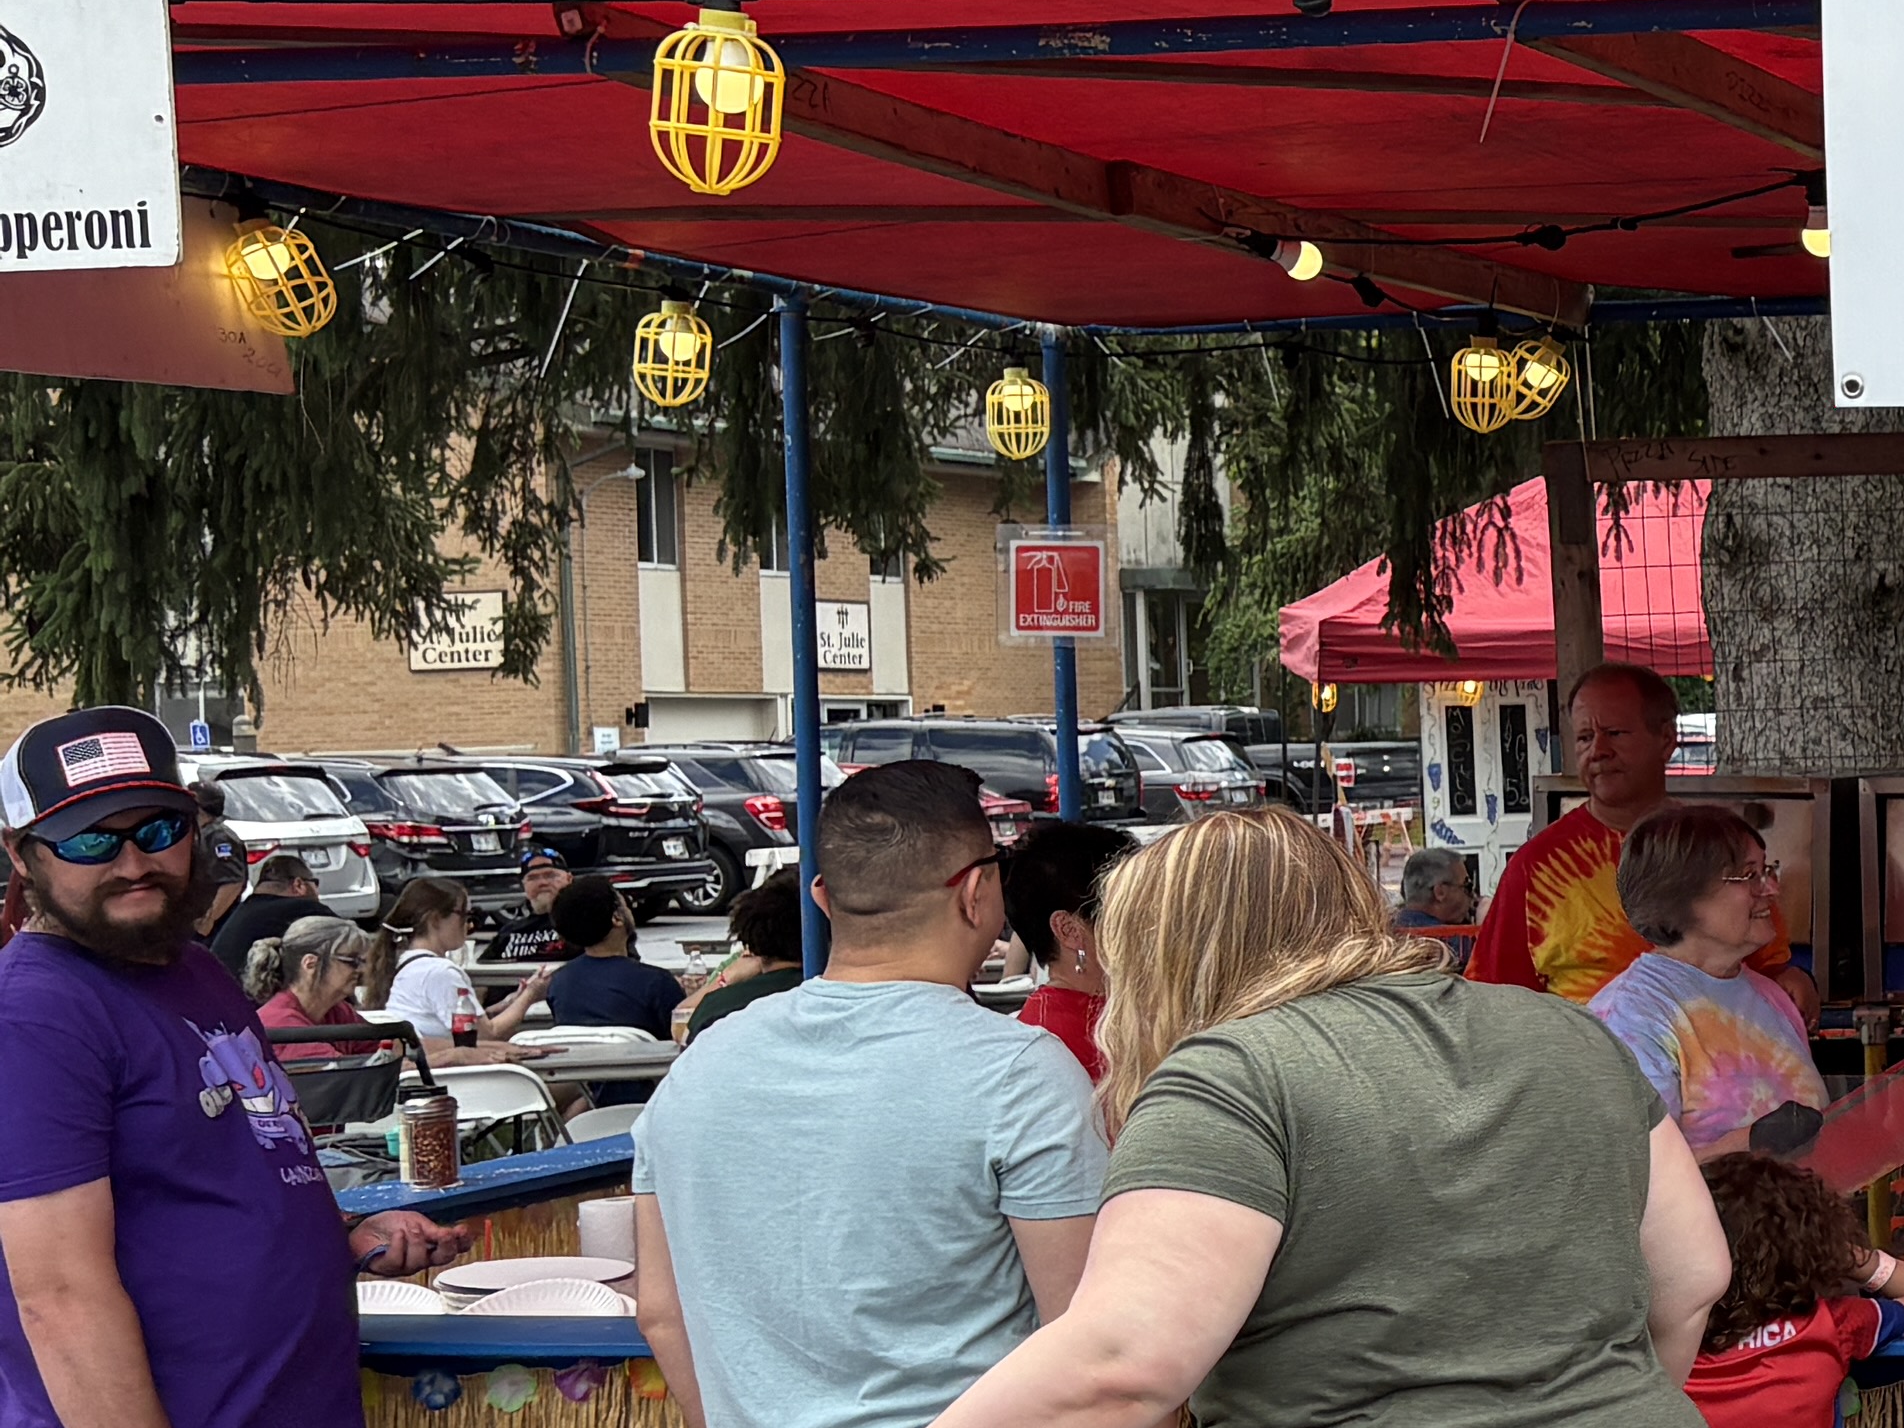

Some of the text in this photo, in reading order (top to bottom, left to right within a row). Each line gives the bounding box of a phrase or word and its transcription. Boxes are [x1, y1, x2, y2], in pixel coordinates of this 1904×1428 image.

[1068, 600, 1092, 613] FIRE
[1019, 613, 1096, 627] EXTINGUISHER
[819, 631, 866, 651] St. Julie
[421, 646, 494, 665] Center
[823, 649, 863, 666] Center
